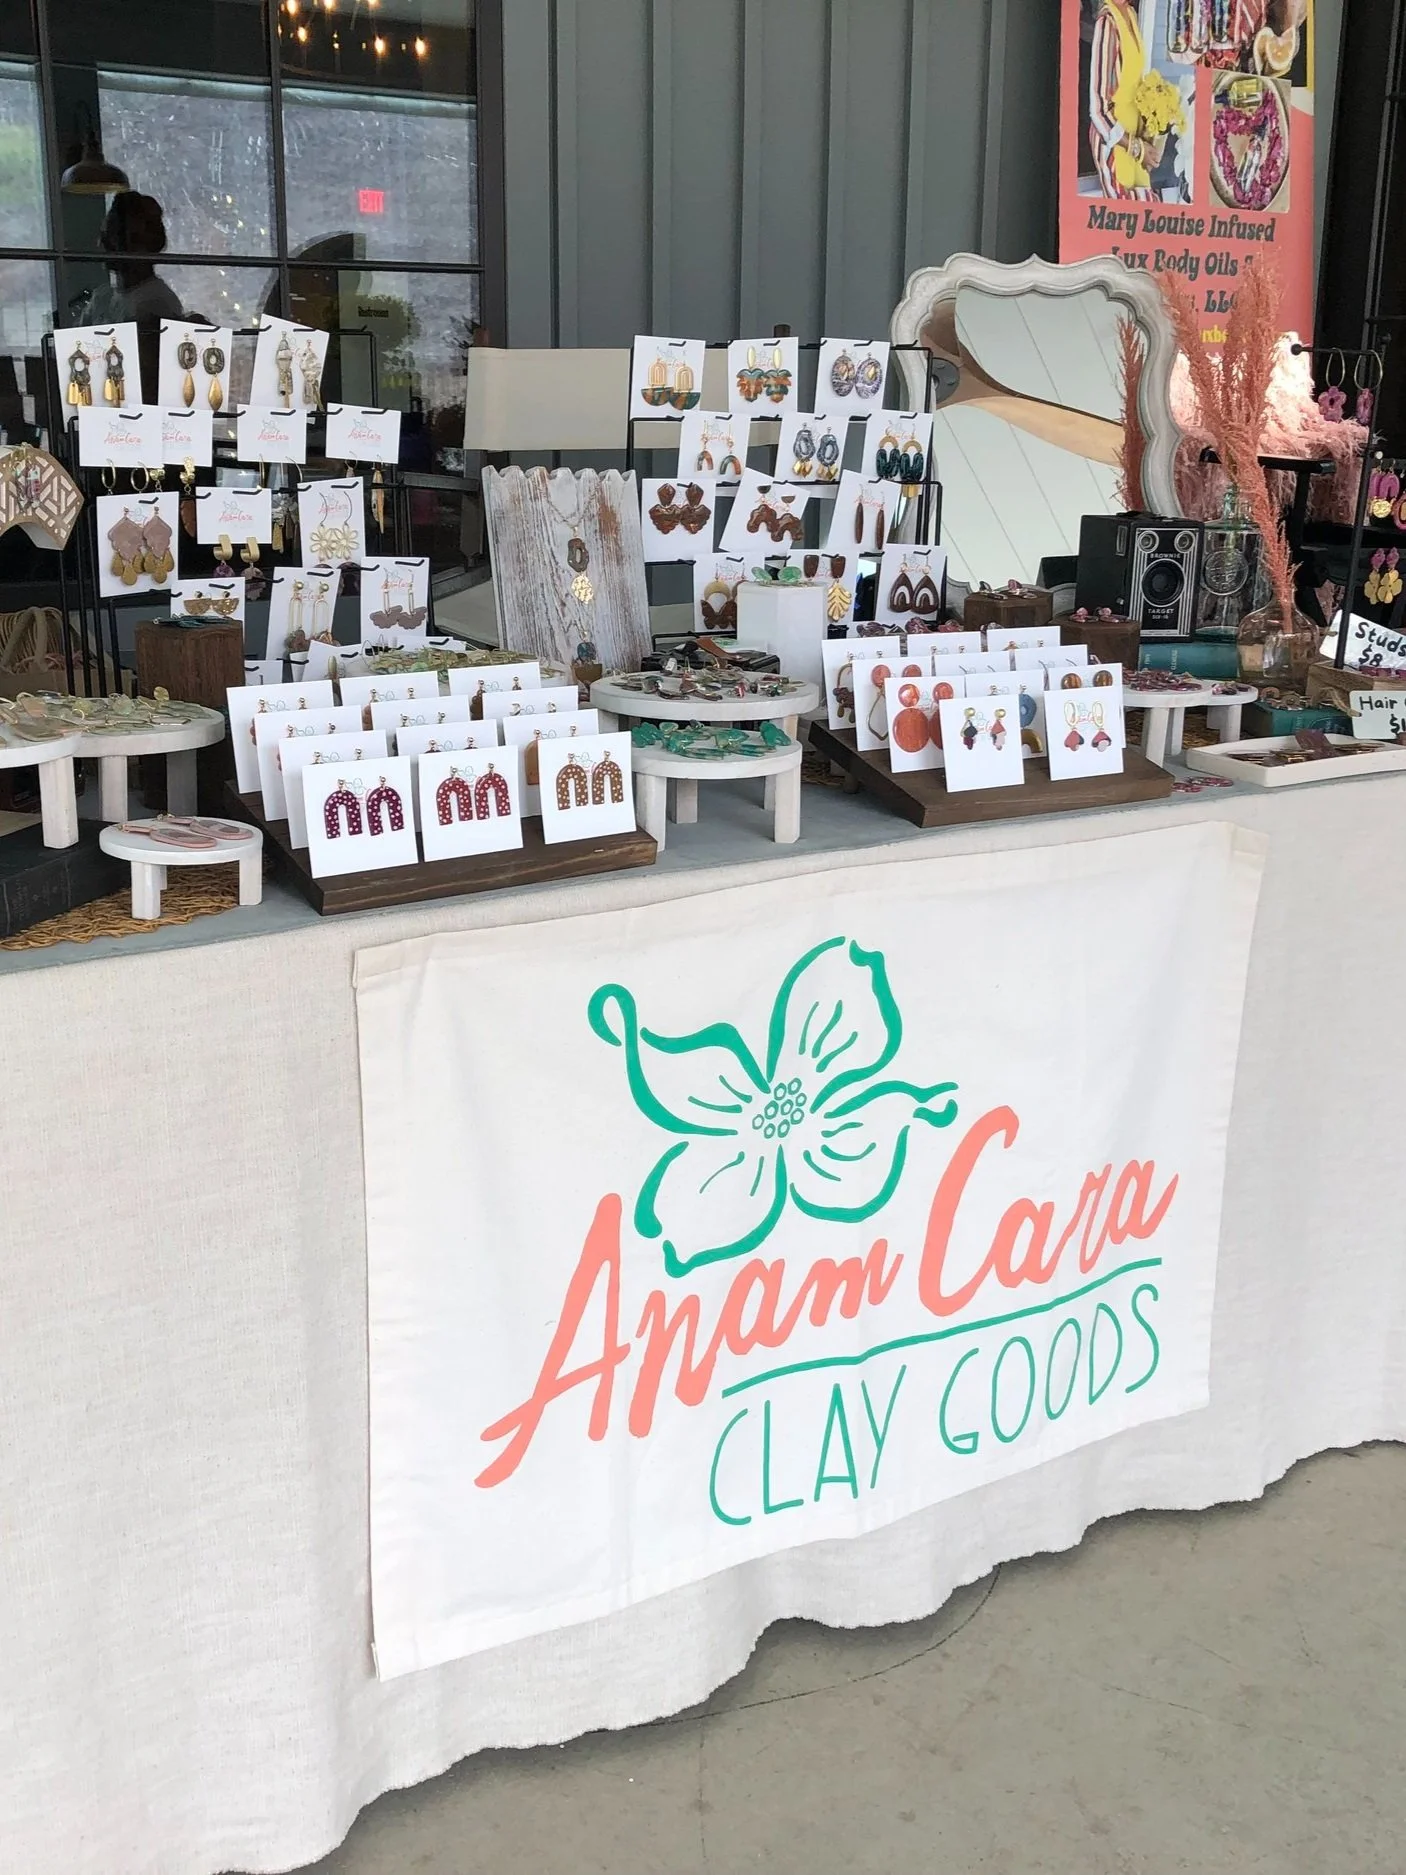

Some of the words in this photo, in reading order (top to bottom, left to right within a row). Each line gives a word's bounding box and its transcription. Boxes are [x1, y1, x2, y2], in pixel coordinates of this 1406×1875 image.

[1087, 205, 1138, 239] Mary
[1142, 209, 1205, 237] Louise
[1208, 214, 1276, 242] Infused
[1153, 249, 1201, 281] Body
[1205, 252, 1238, 276] Oils
[1355, 621, 1406, 657] Studs
[1359, 644, 1384, 667] $8
[1359, 695, 1398, 710] Hair
[474, 1193, 904, 1489] Anam
[919, 1105, 1179, 1317] Cara
[709, 1364, 907, 1527] CLAY
[939, 1283, 1161, 1456] GOODS
